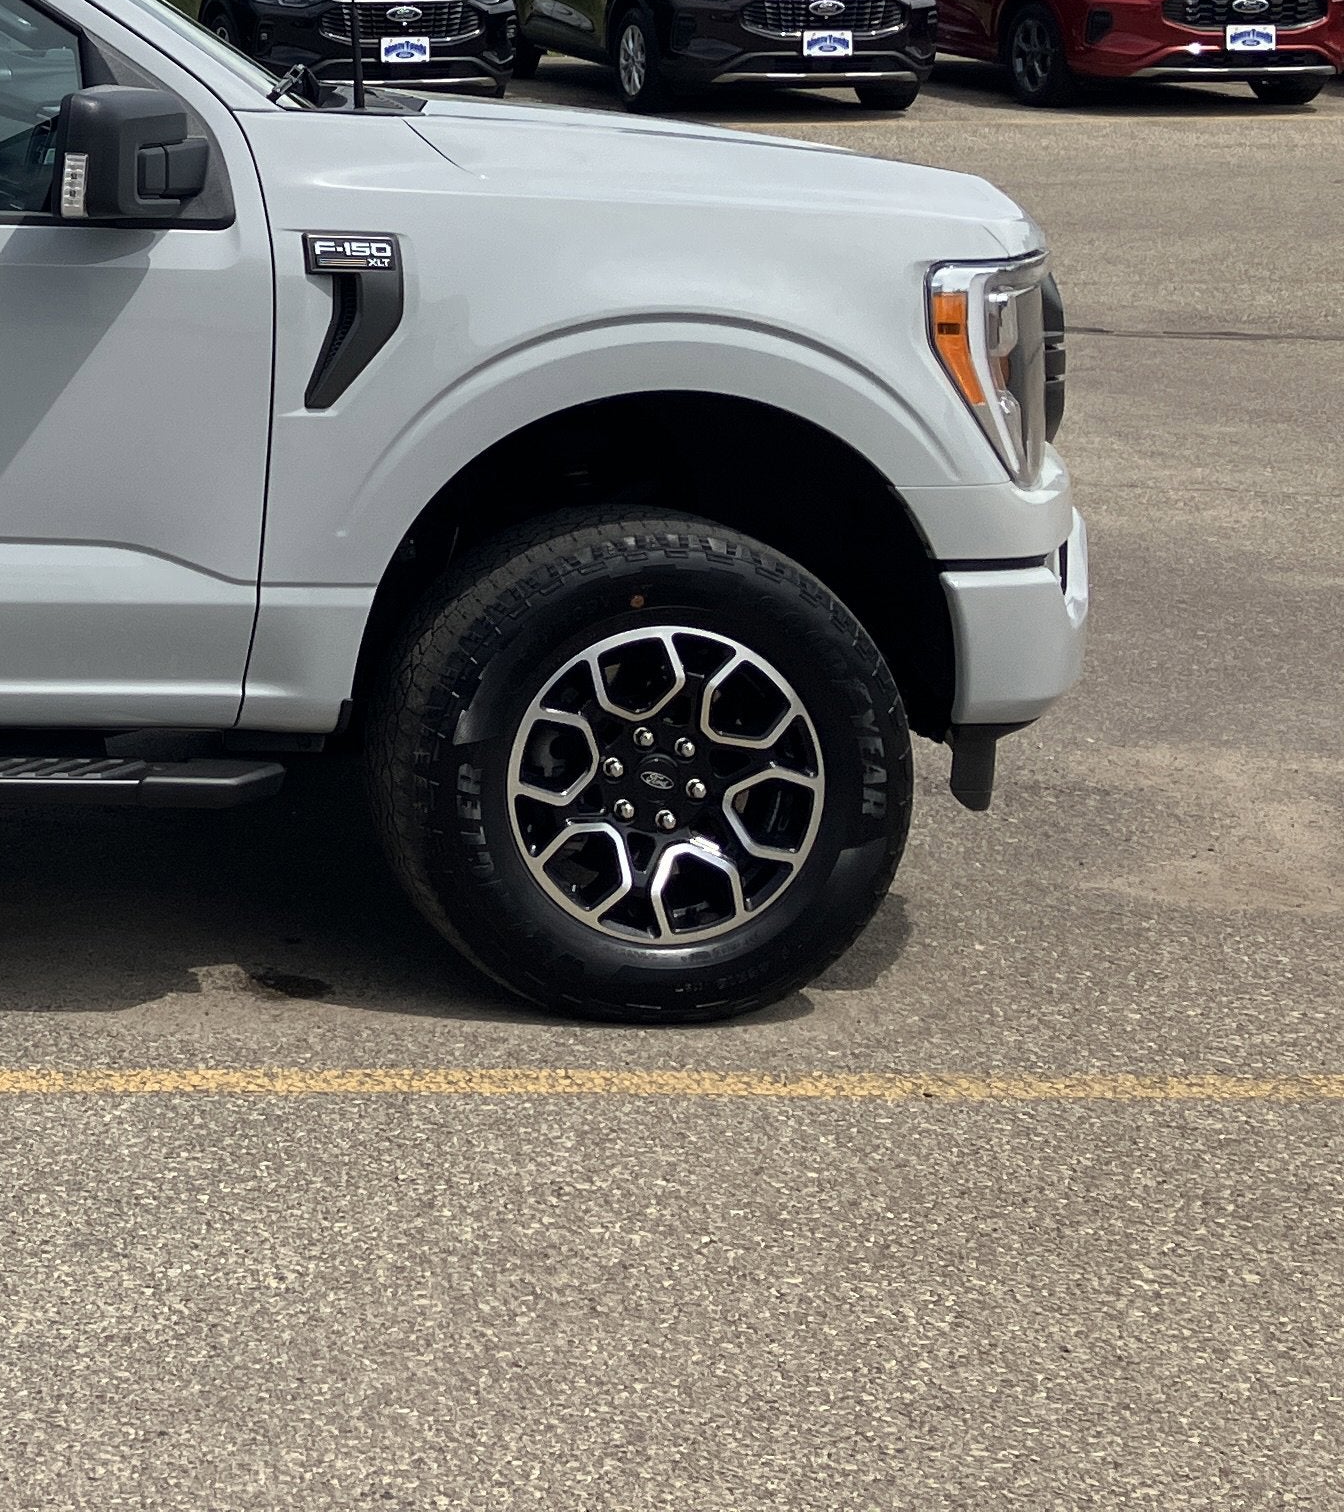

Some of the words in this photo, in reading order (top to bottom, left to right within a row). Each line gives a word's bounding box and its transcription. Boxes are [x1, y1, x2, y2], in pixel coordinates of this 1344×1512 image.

[314, 241, 392, 257] F-150
[367, 258, 391, 267] XLT
[645, 773, 670, 788] Ford
